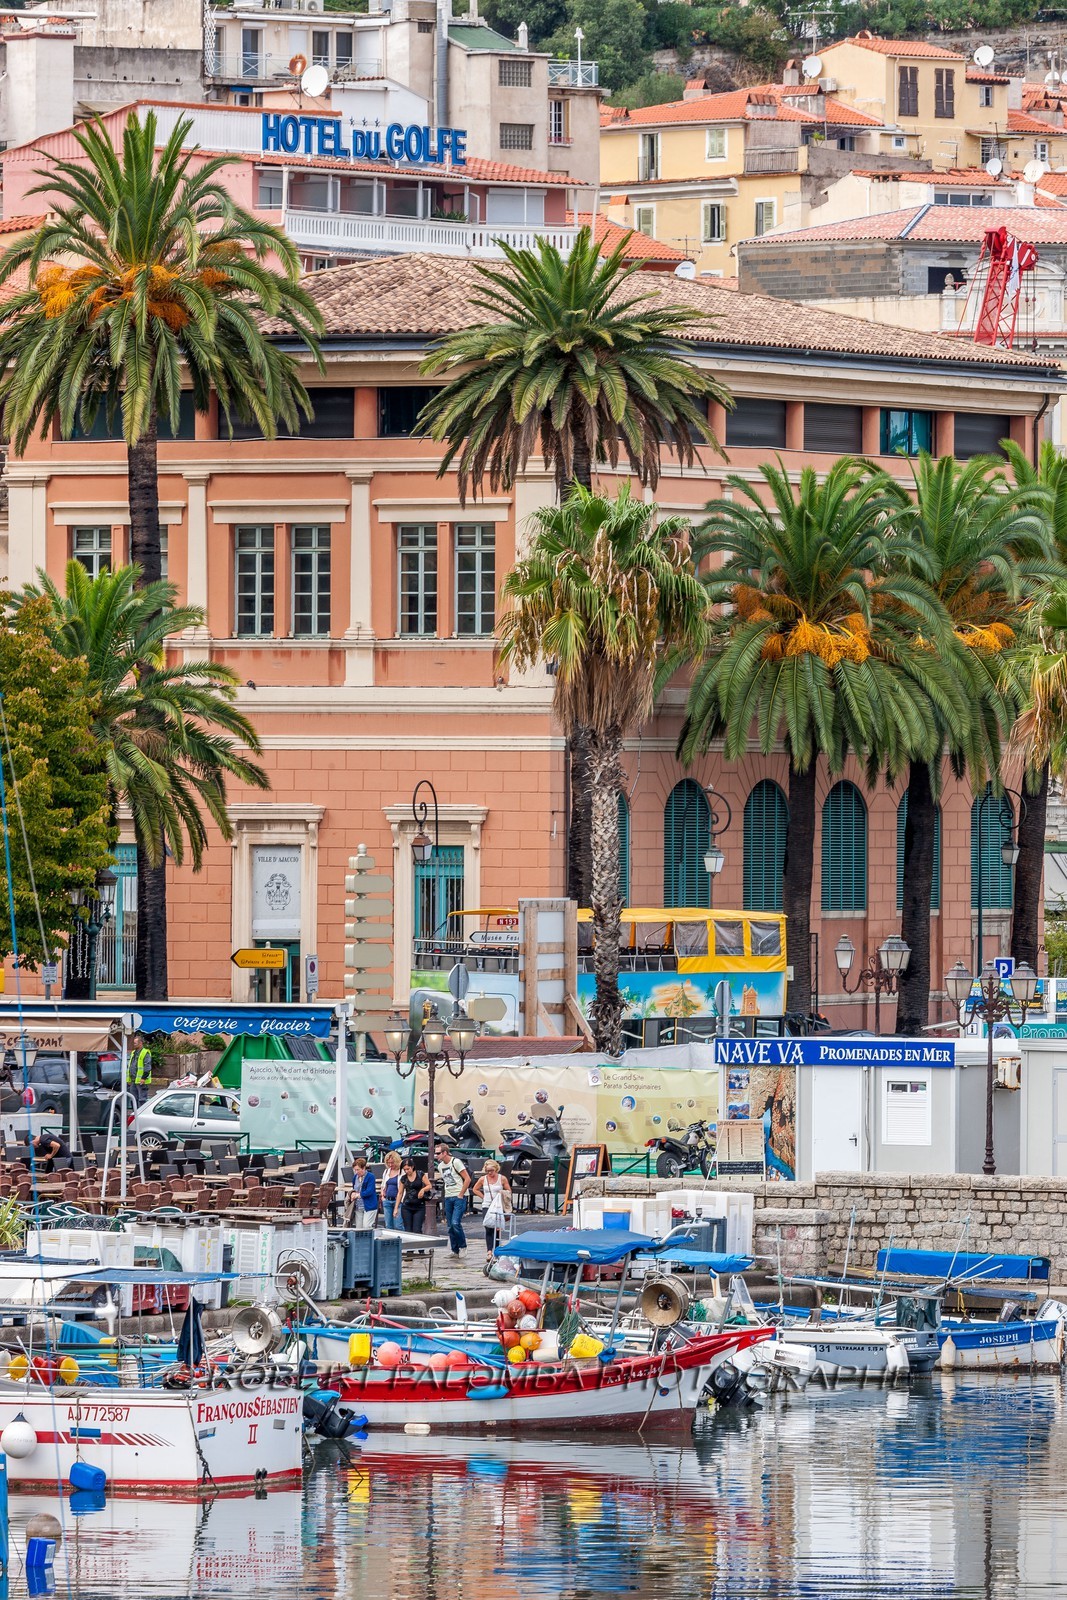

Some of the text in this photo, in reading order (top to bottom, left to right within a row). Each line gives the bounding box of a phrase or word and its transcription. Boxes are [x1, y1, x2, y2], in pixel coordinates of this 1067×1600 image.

[262, 113, 467, 166] HOTEL DU GOLFE
[1000, 963, 1008, 978] P
[173, 1016, 238, 1031] Crêperie
[716, 1040, 951, 1064] NAVE VA PROMENADES EN MER
[980, 1334, 1018, 1344] JOSEPH
[68, 1406, 130, 1422] AJ772587
